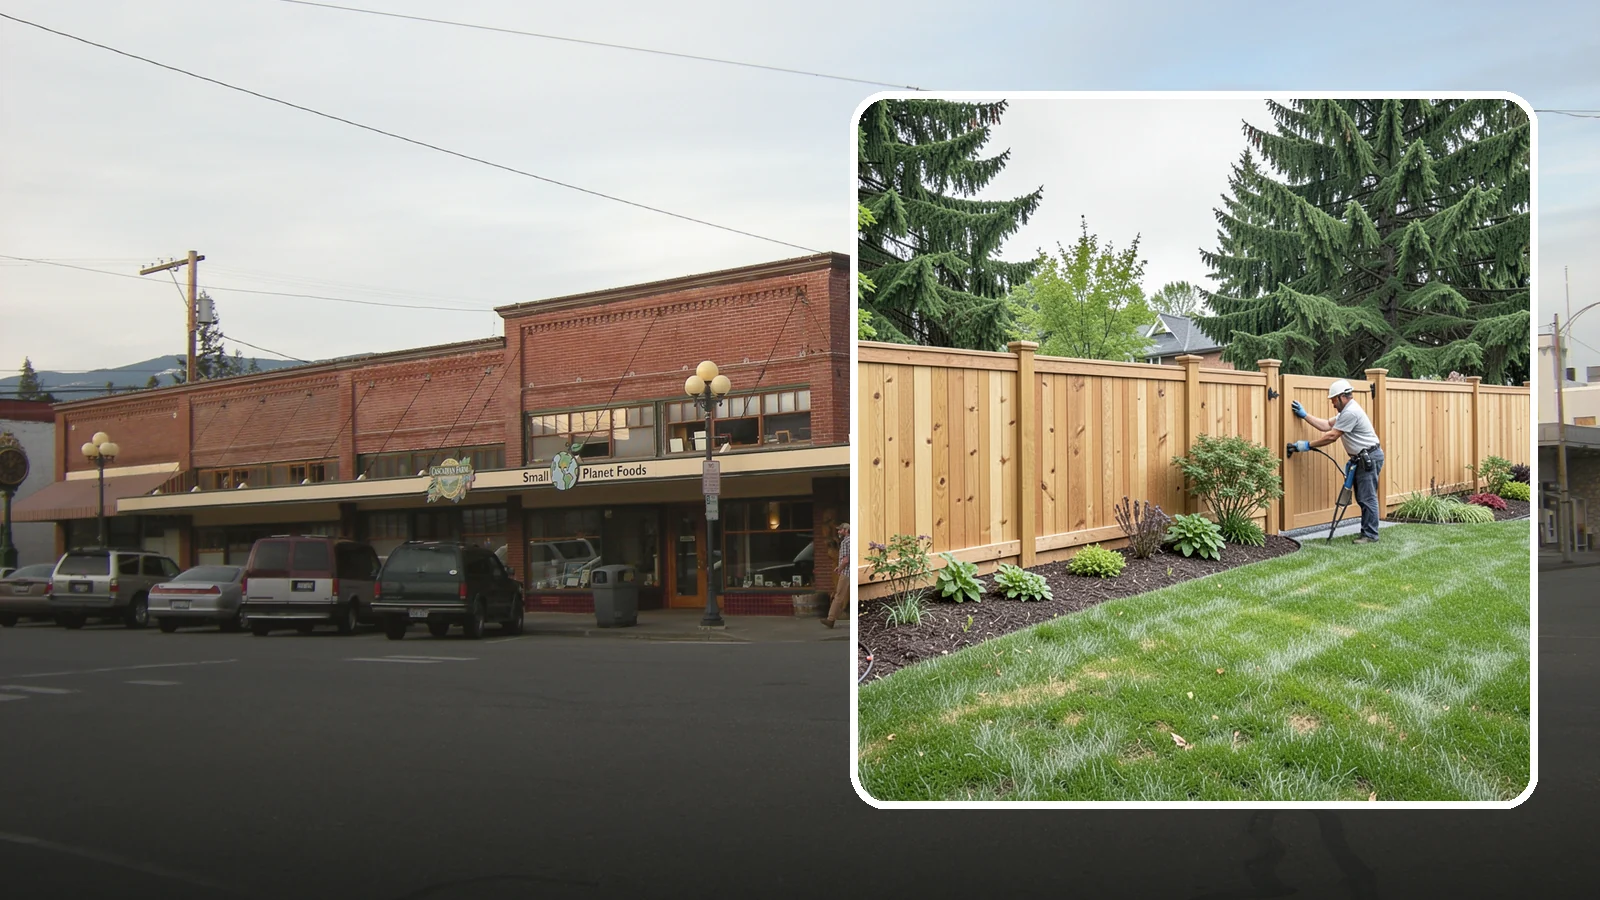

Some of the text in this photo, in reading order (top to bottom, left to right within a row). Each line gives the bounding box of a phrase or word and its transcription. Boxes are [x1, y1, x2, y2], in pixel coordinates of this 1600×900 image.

[523, 464, 647, 483] Small Planet Foods
